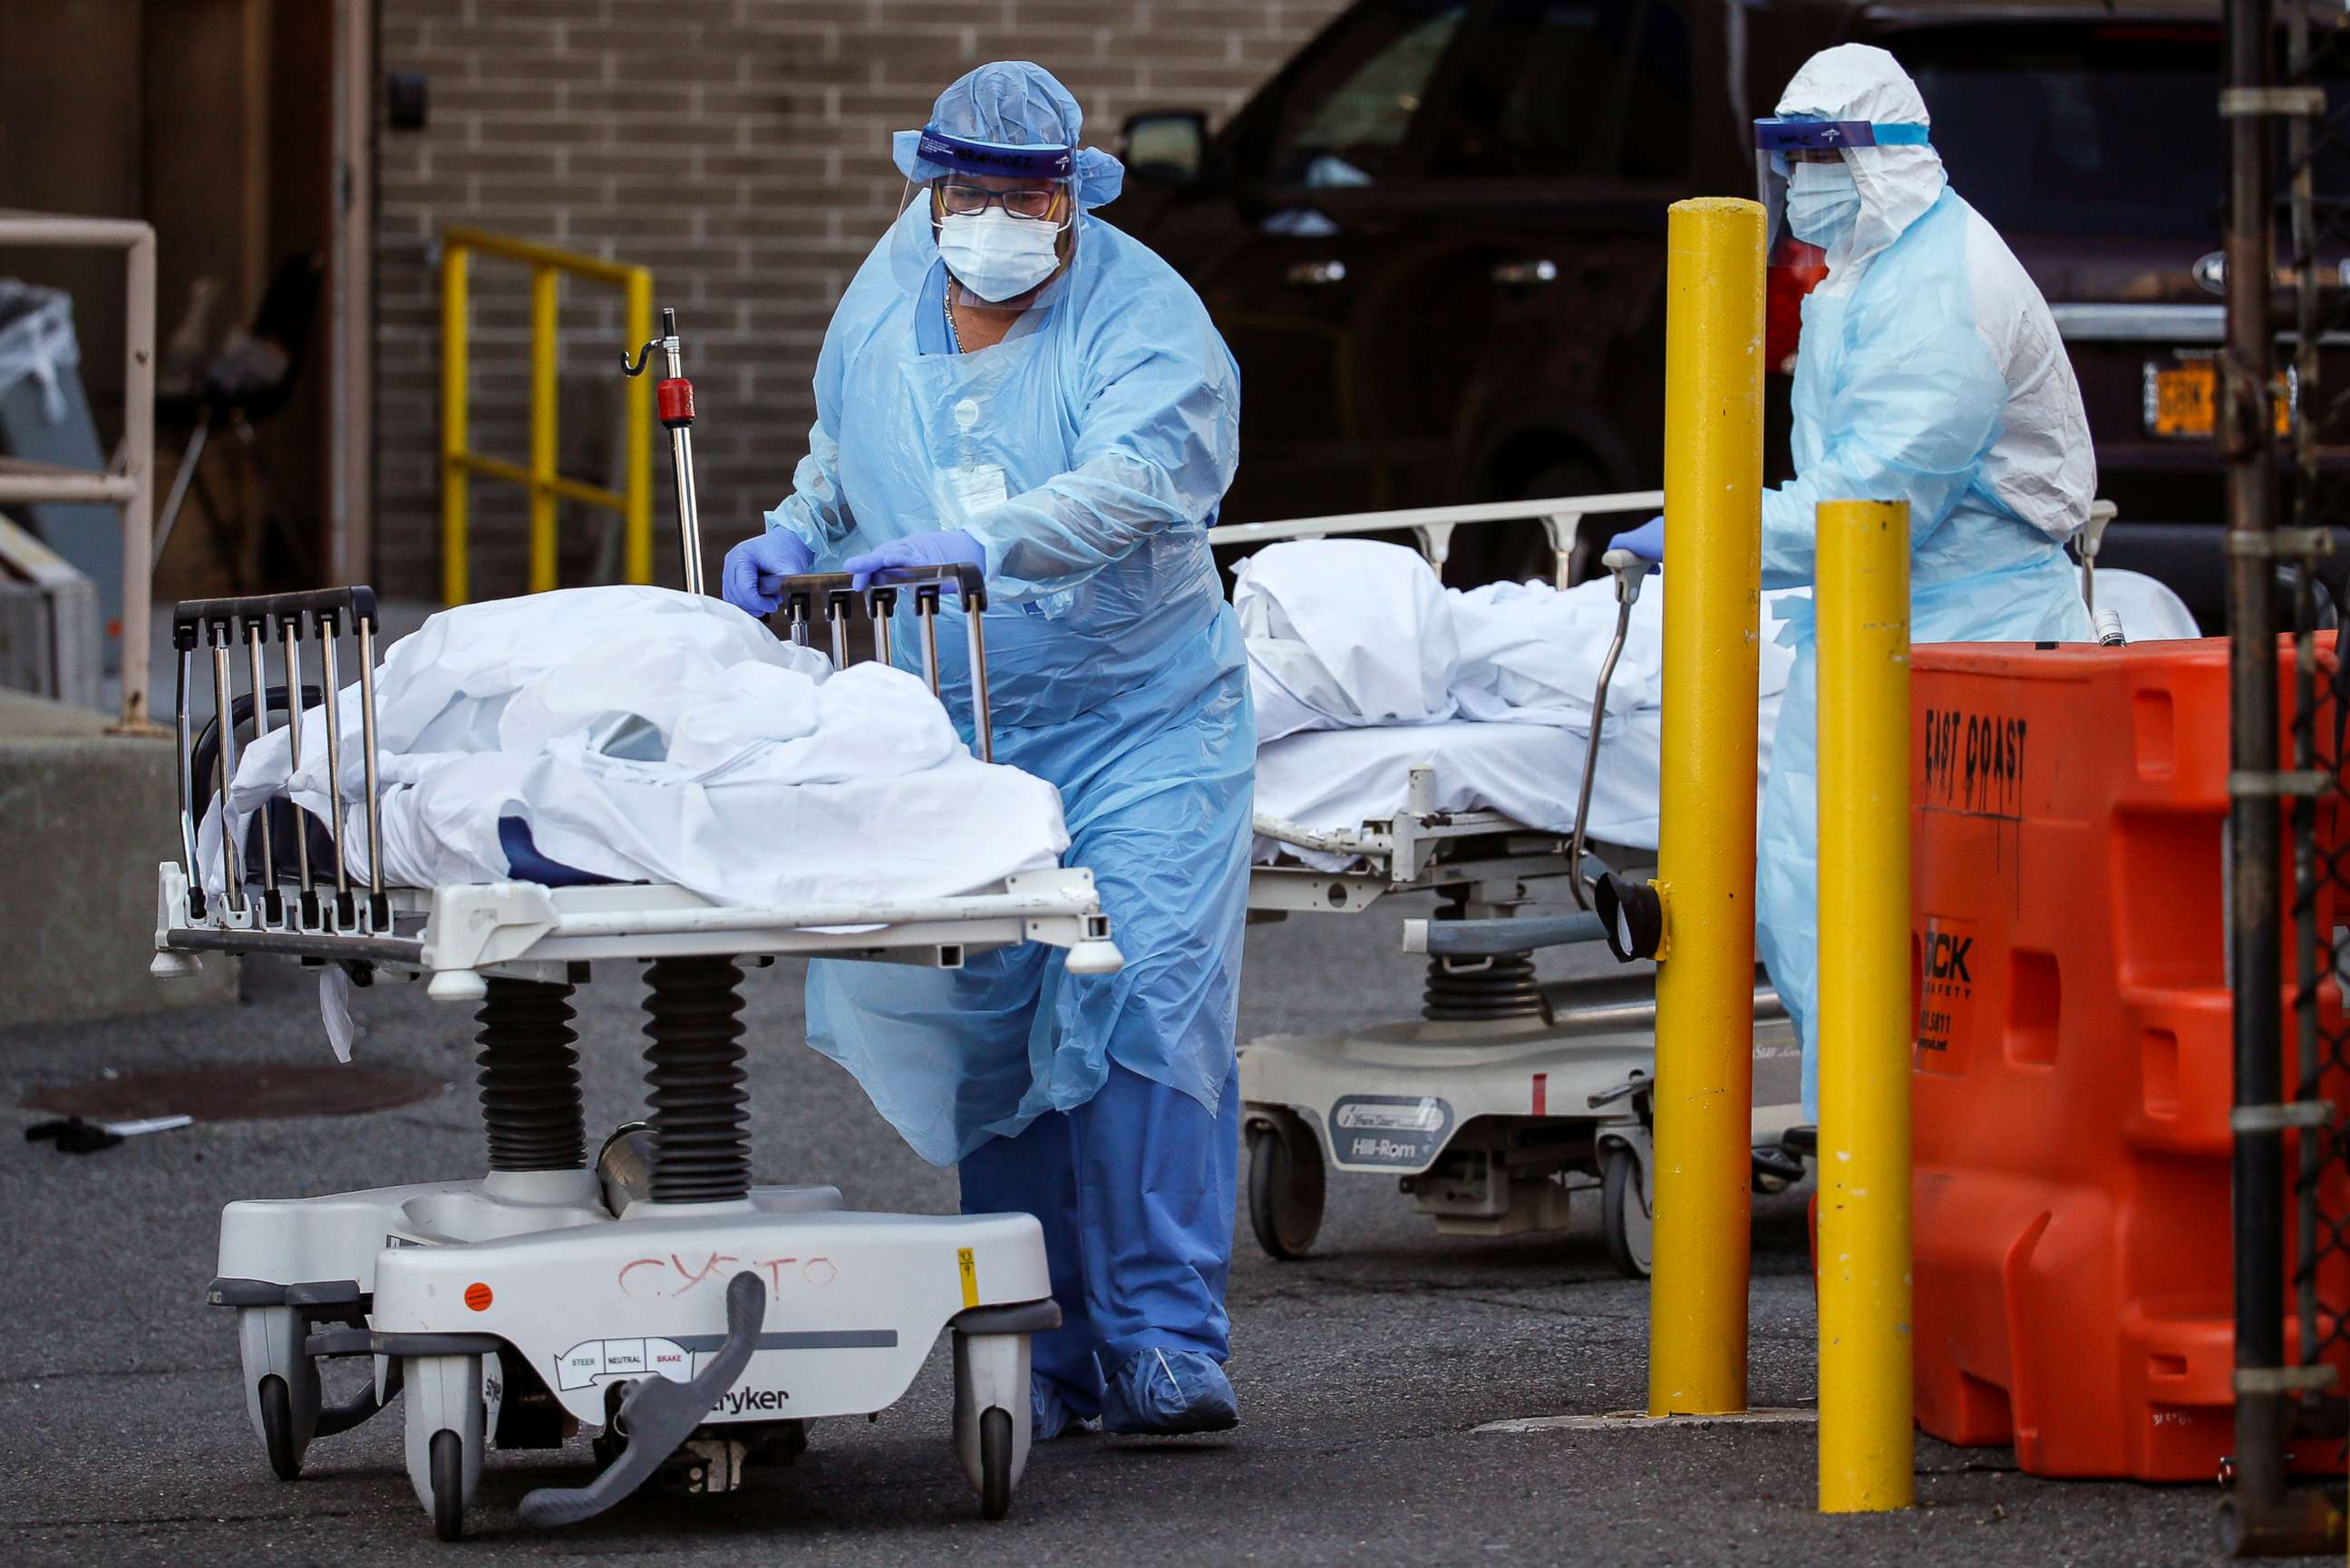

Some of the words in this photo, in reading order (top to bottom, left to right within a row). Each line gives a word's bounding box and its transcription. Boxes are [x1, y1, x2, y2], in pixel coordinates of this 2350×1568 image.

[1925, 710, 1961, 776] EAST
[1966, 714, 2027, 783] COAST
[1352, 1137, 1416, 1157] Hill-Rom
[572, 1359, 596, 1367] STEER
[608, 1356, 641, 1364] NEUTRAL
[656, 1354, 682, 1363] BRAKE
[712, 1386, 789, 1415] ryker
